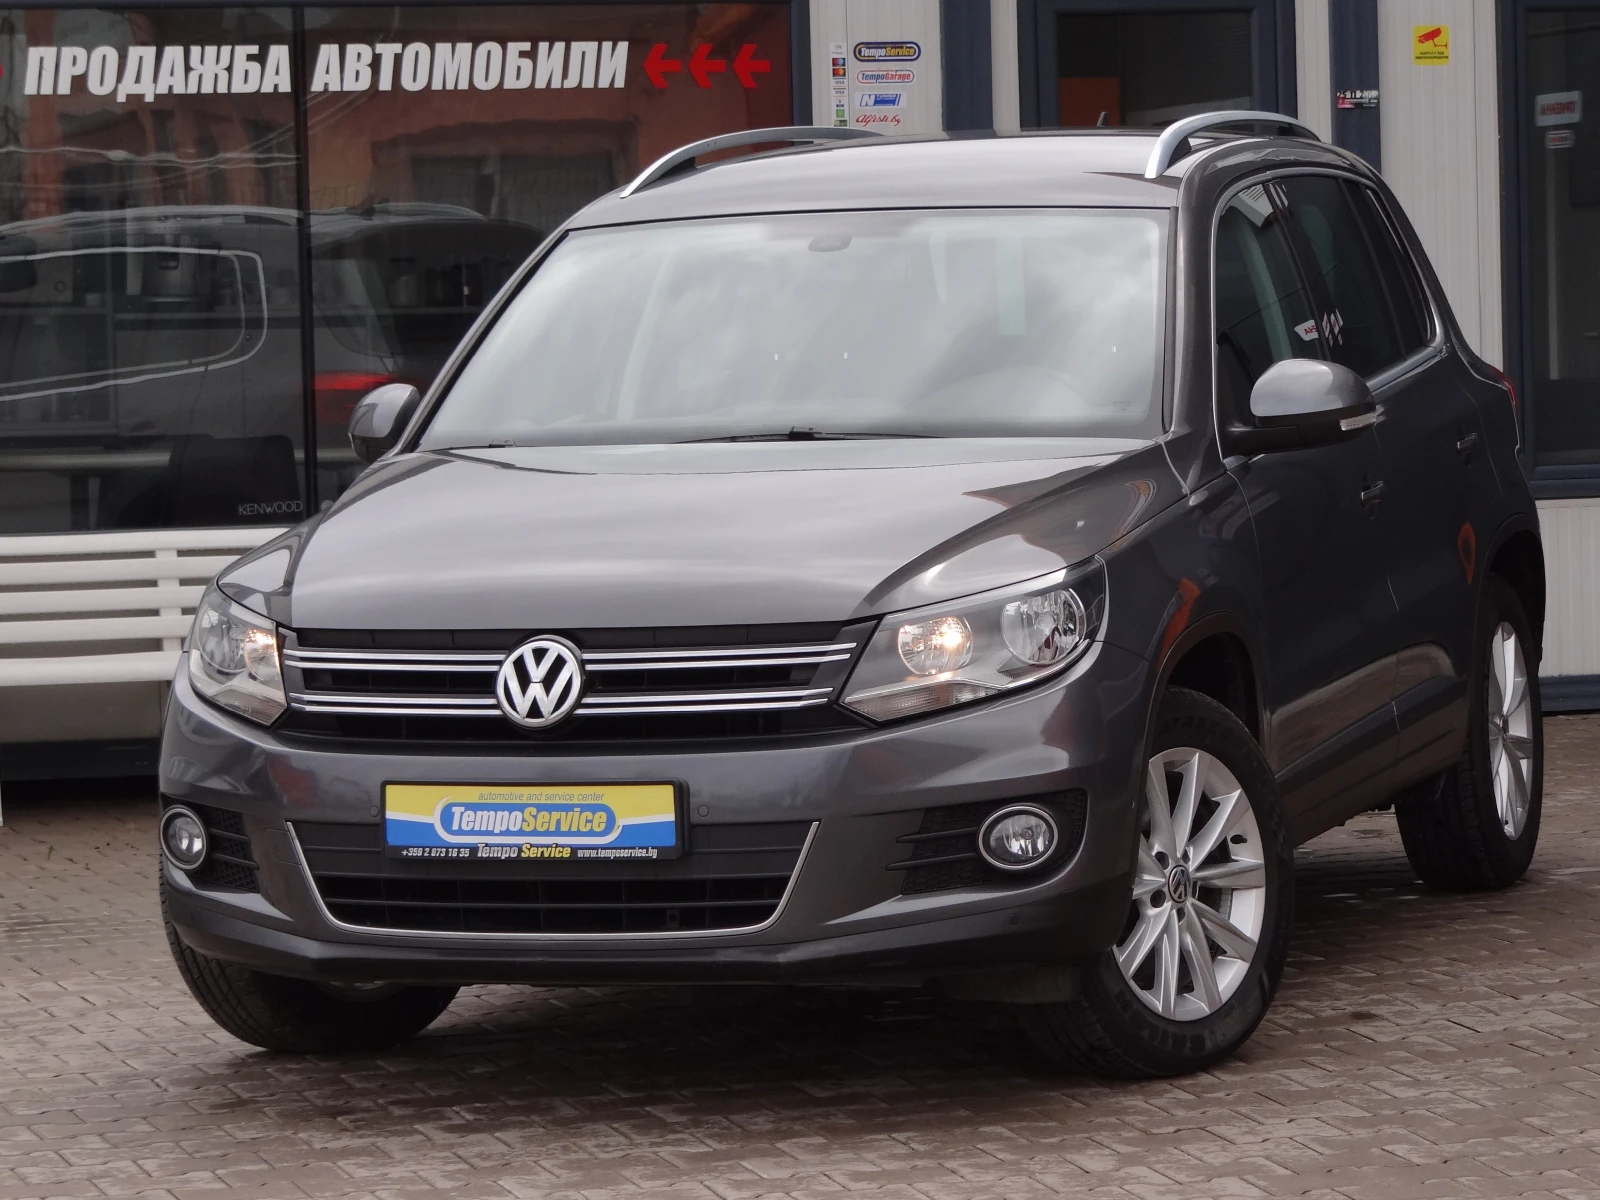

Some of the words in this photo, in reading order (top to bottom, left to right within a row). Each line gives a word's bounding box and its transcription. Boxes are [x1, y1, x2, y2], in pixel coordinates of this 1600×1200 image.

[860, 46, 915, 60] TempoService
[23, 45, 292, 103] ПРОДАЖБА
[311, 41, 629, 93] АВТОМОБИЛИ
[861, 72, 911, 84] TempoGarage
[238, 500, 303, 515] KENWOOD
[478, 791, 524, 801] automotive
[526, 791, 543, 801] and
[544, 792, 575, 802] service
[576, 792, 605, 802] center
[451, 806, 608, 833] TempoService
[424, 847, 430, 857] 2
[448, 848, 458, 858] 16
[459, 848, 470, 858] 35
[477, 843, 519, 860] Tempo
[521, 843, 572, 859] Service
[577, 847, 658, 859] www.temposervice.bg
